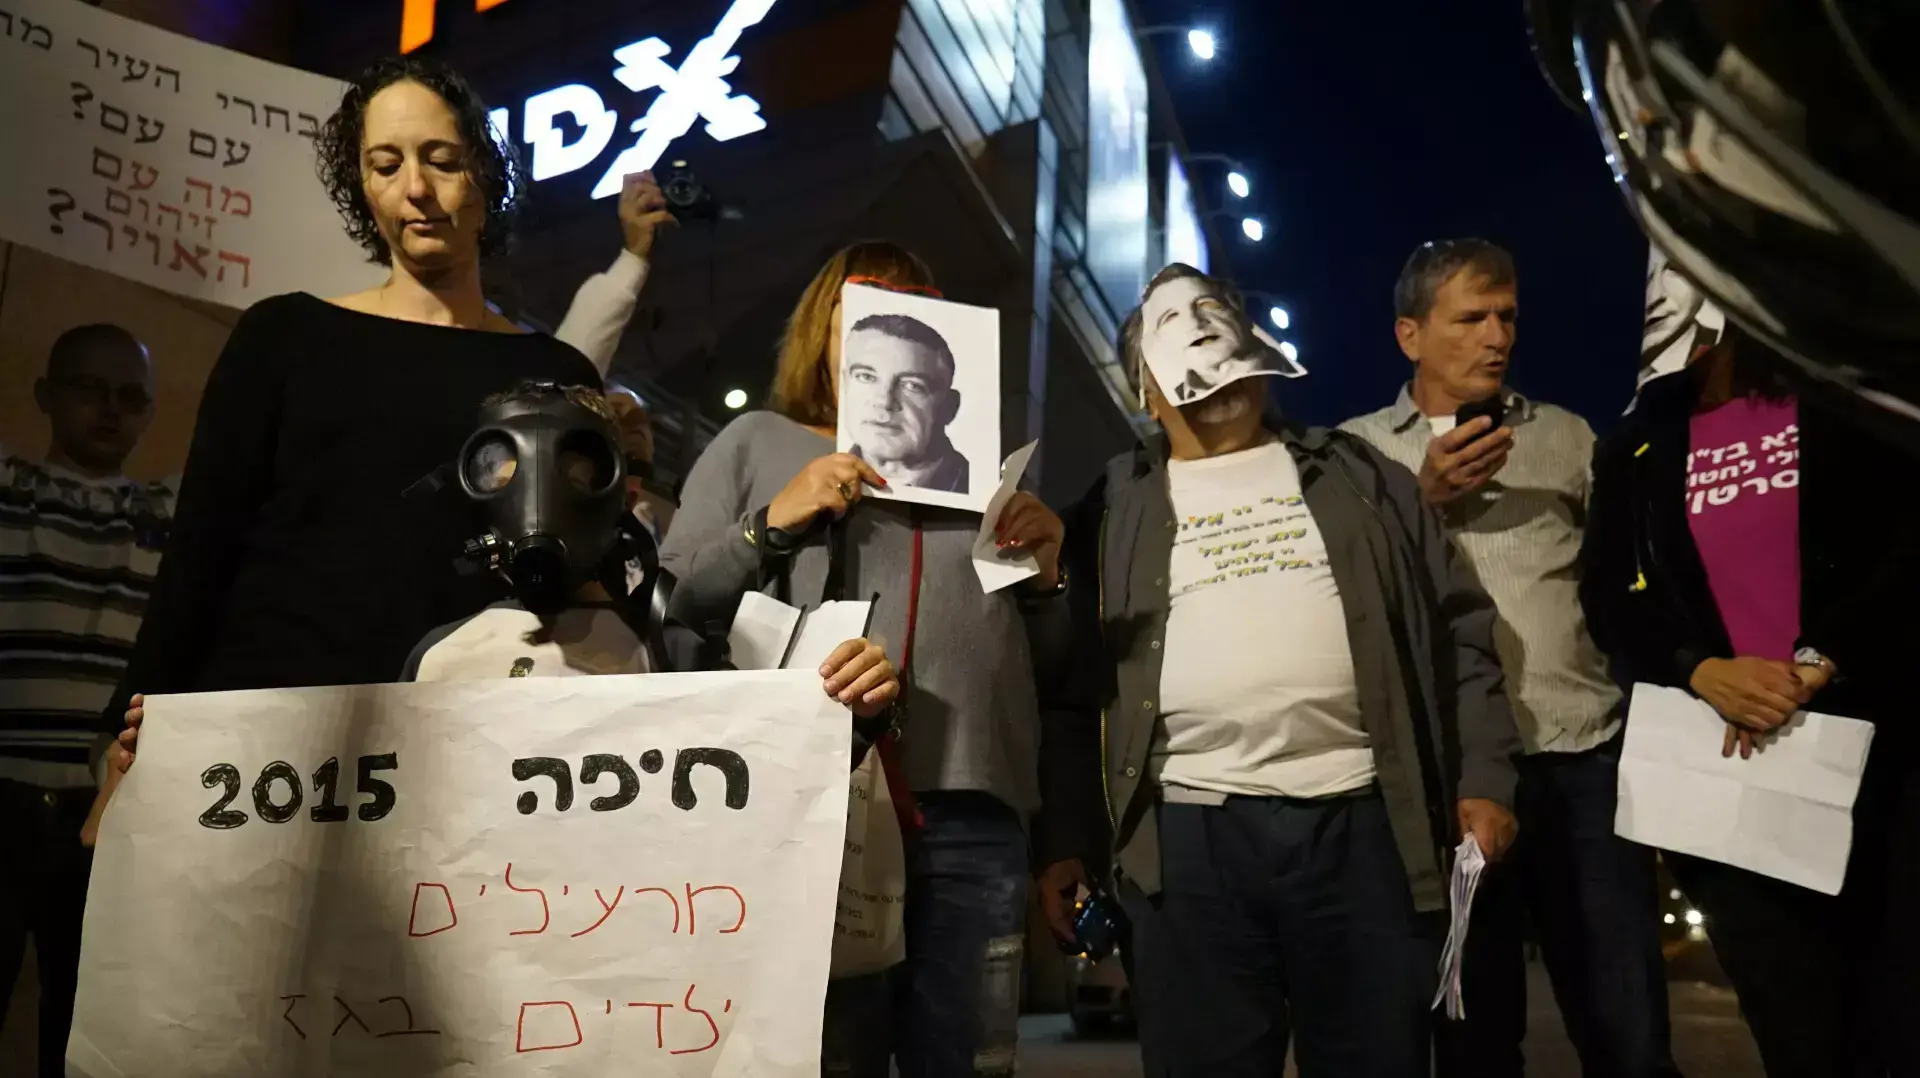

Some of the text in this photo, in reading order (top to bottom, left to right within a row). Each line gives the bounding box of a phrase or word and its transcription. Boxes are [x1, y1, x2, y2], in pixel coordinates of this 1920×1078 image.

[76, 38, 181, 93] העיר
[70, 81, 251, 168] עם עם?
[92, 147, 252, 217] מה עם
[105, 186, 218, 240] זיהום
[47, 187, 251, 288] האויר?
[1685, 459, 1756, 488] לחטו
[198, 747, 750, 830] חיפה 2015
[408, 862, 746, 938] מרעילים
[279, 983, 732, 1055] ילדים בגז
